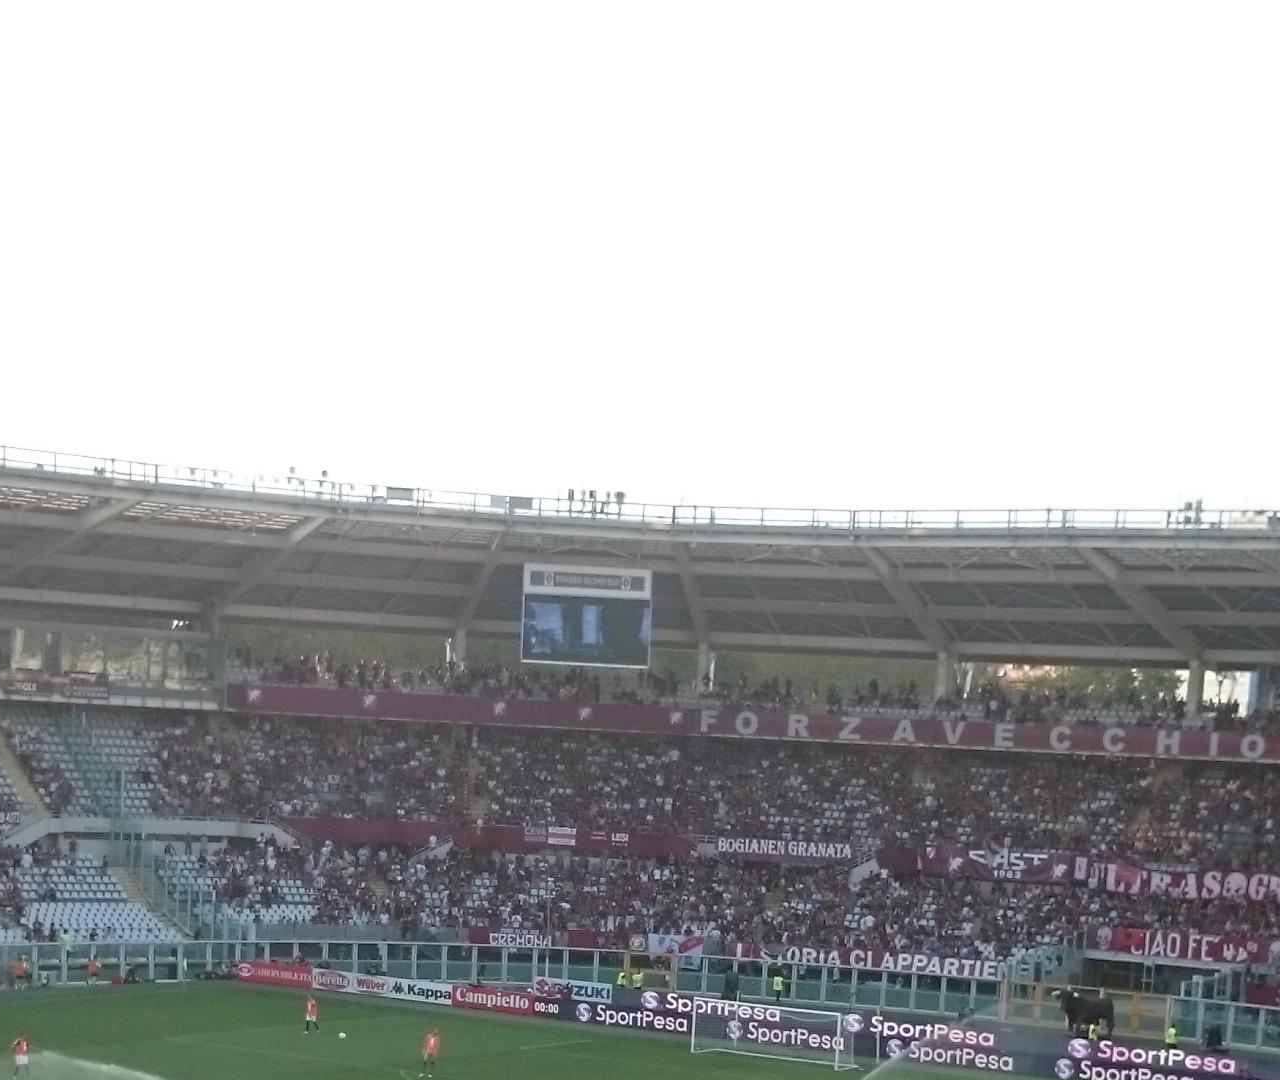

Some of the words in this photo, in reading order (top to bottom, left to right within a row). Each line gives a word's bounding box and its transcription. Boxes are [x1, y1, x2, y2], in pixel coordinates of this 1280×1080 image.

[718, 837, 785, 855] BOGIANEN
[788, 841, 852, 859] GRANATA
[489, 933, 552, 947] CREMONA
[315, 972, 349, 987] Beretta
[407, 984, 452, 1000] Kappa
[456, 987, 530, 1010] Campiello
[534, 1002, 559, 1014] 00:00
[666, 992, 781, 1021] SportPesa
[596, 1005, 688, 1032] SportPesa
[870, 1015, 995, 1046] SportPesa
[747, 1021, 844, 1052] SportPesa
[909, 1042, 1014, 1072] SportPesa
[1098, 1040, 1236, 1074] SportPesa
